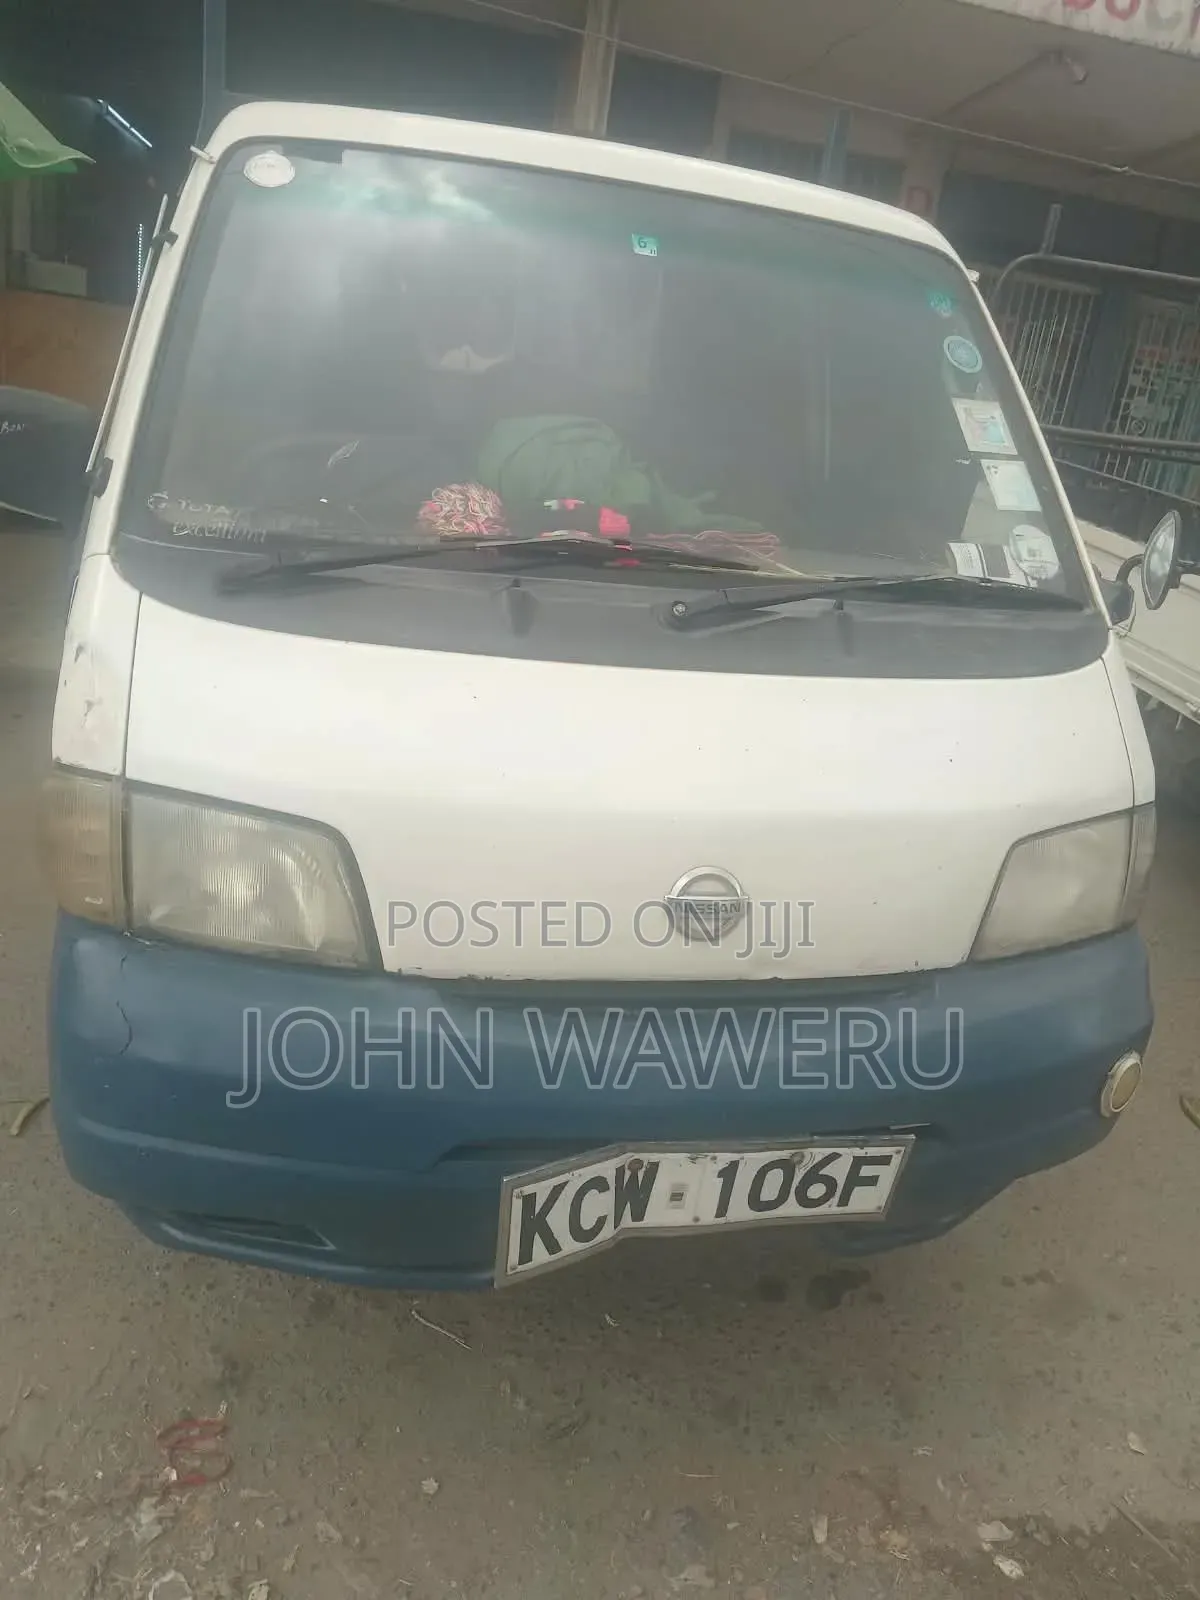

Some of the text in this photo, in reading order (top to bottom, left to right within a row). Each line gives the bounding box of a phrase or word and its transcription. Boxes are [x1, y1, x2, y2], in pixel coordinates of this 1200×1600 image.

[673, 902, 741, 914] NISSAN
[517, 1151, 893, 1266] KCW 106F
